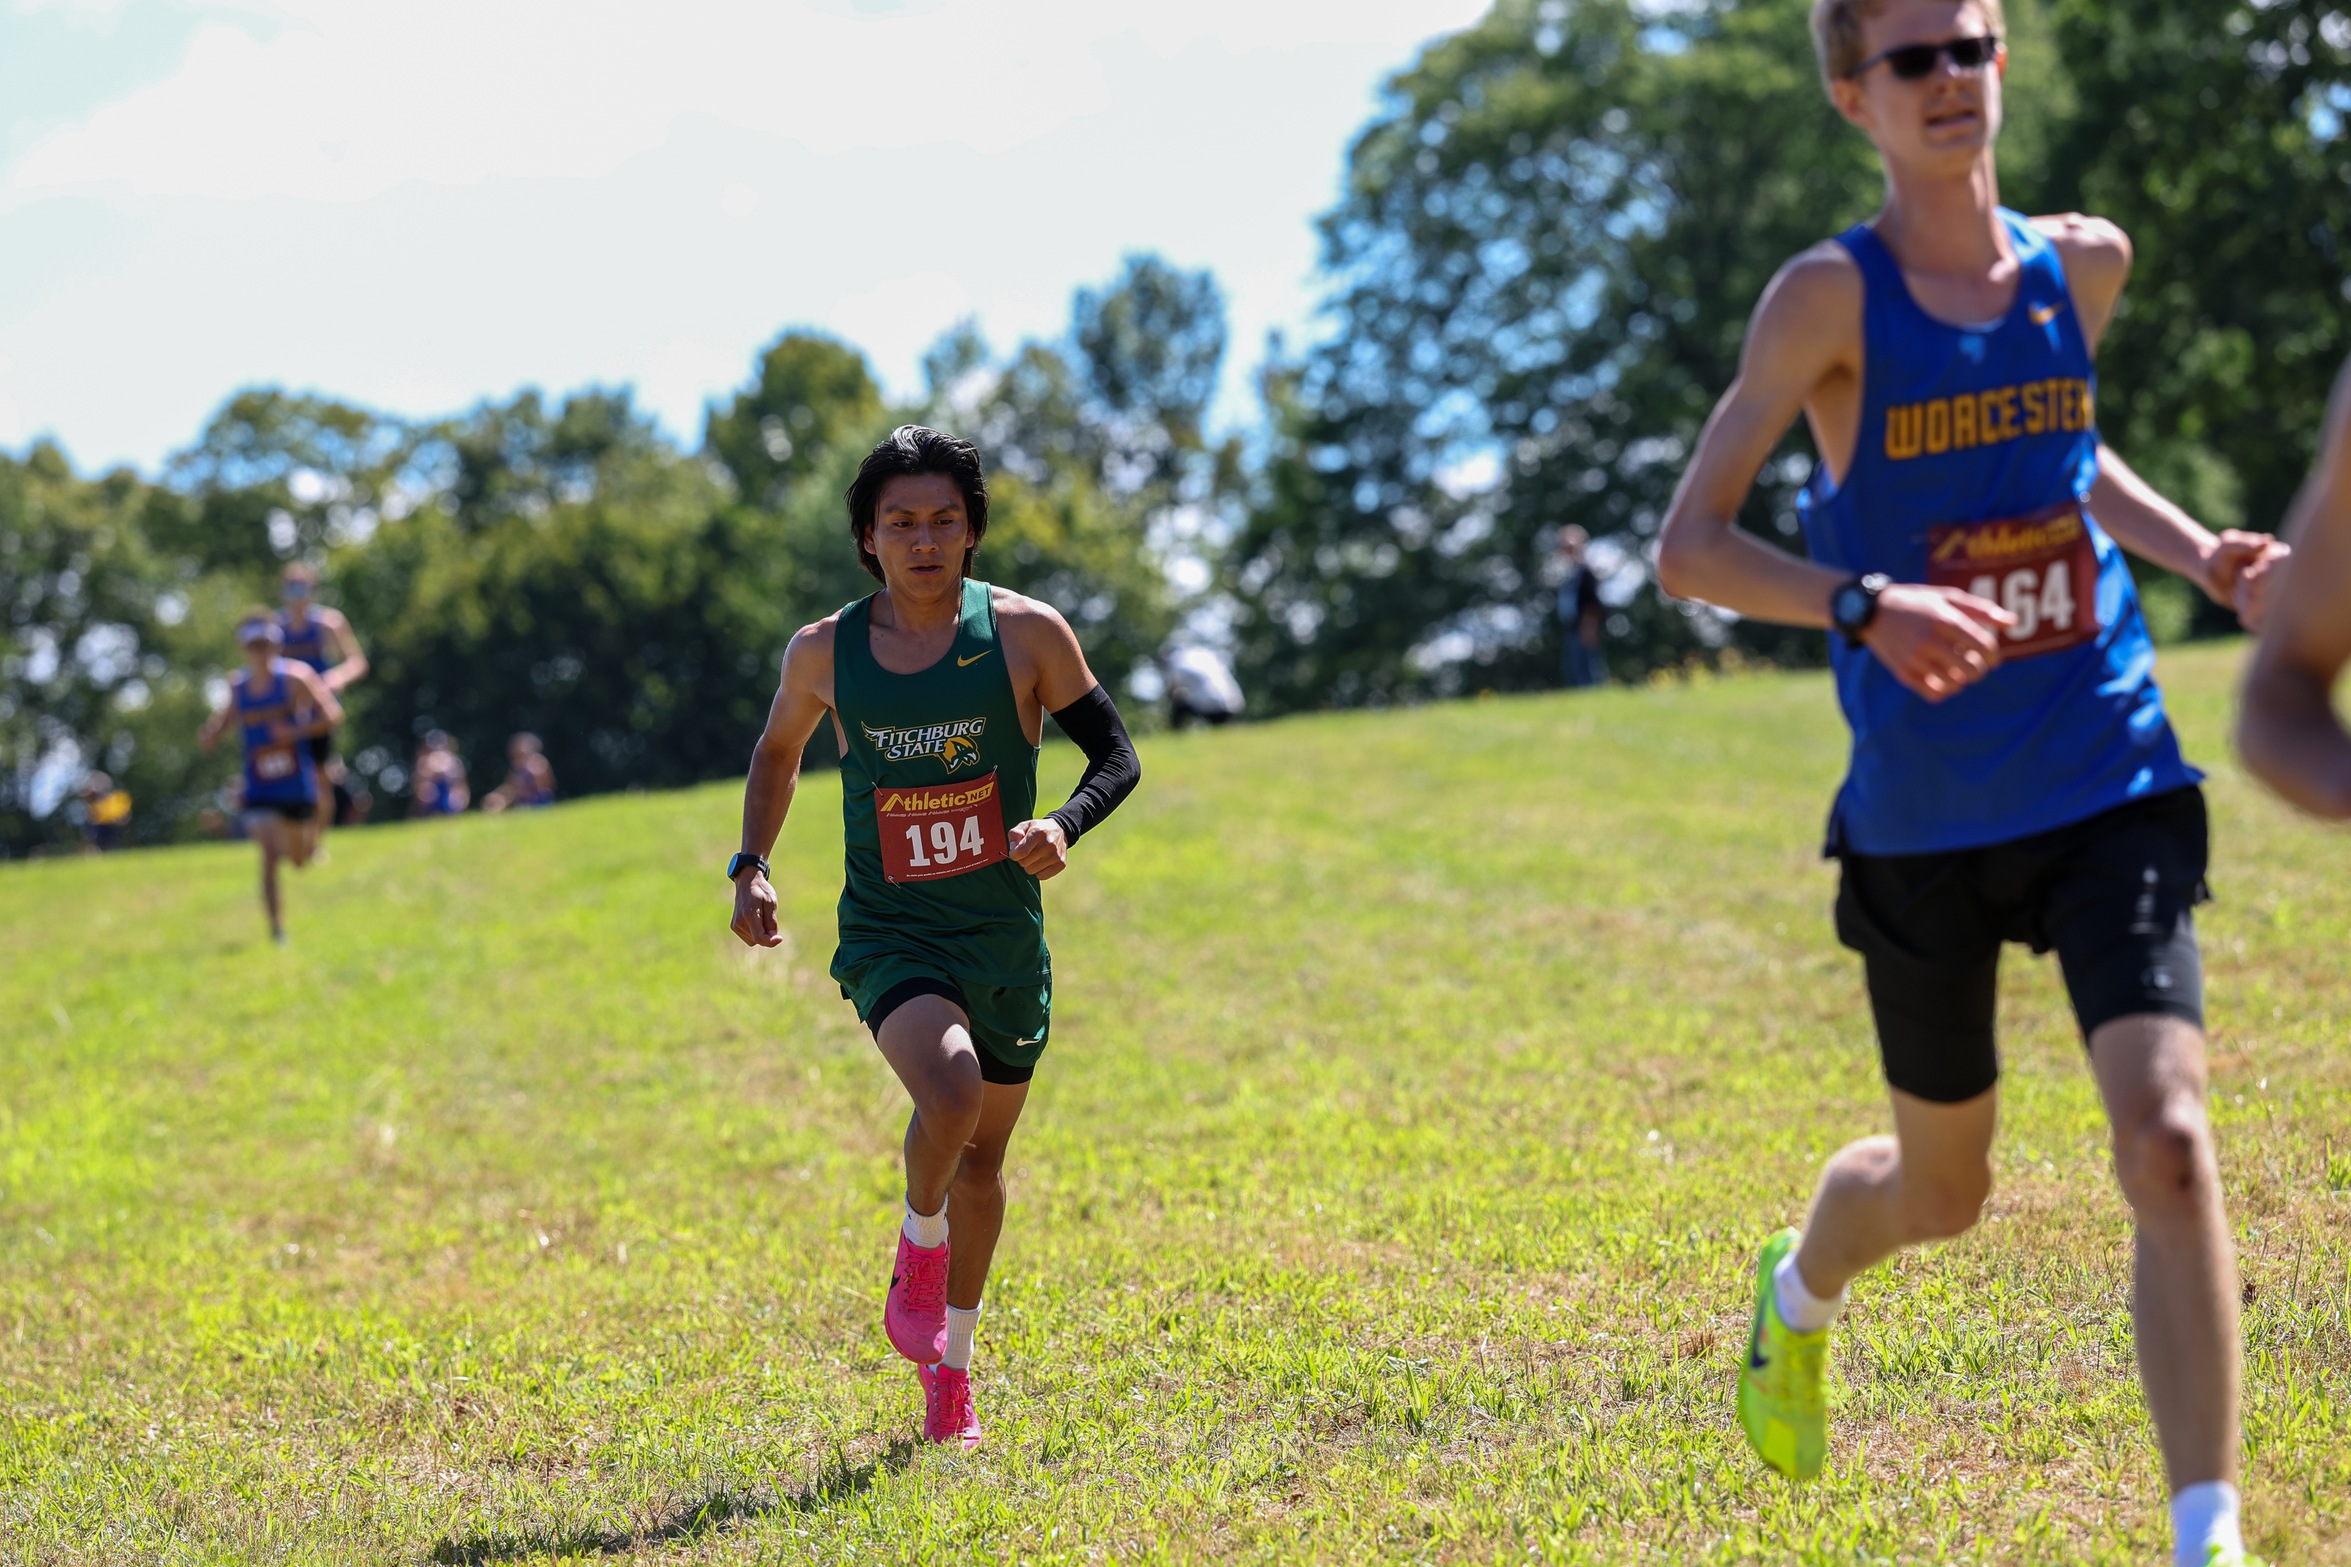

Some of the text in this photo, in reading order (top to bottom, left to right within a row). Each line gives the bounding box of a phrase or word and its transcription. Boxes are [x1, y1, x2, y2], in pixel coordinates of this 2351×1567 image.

[867, 718, 984, 748] FITCHBURG
[887, 740, 945, 760] STATE
[880, 791, 967, 812] Athletic
[905, 815, 985, 867] 194
